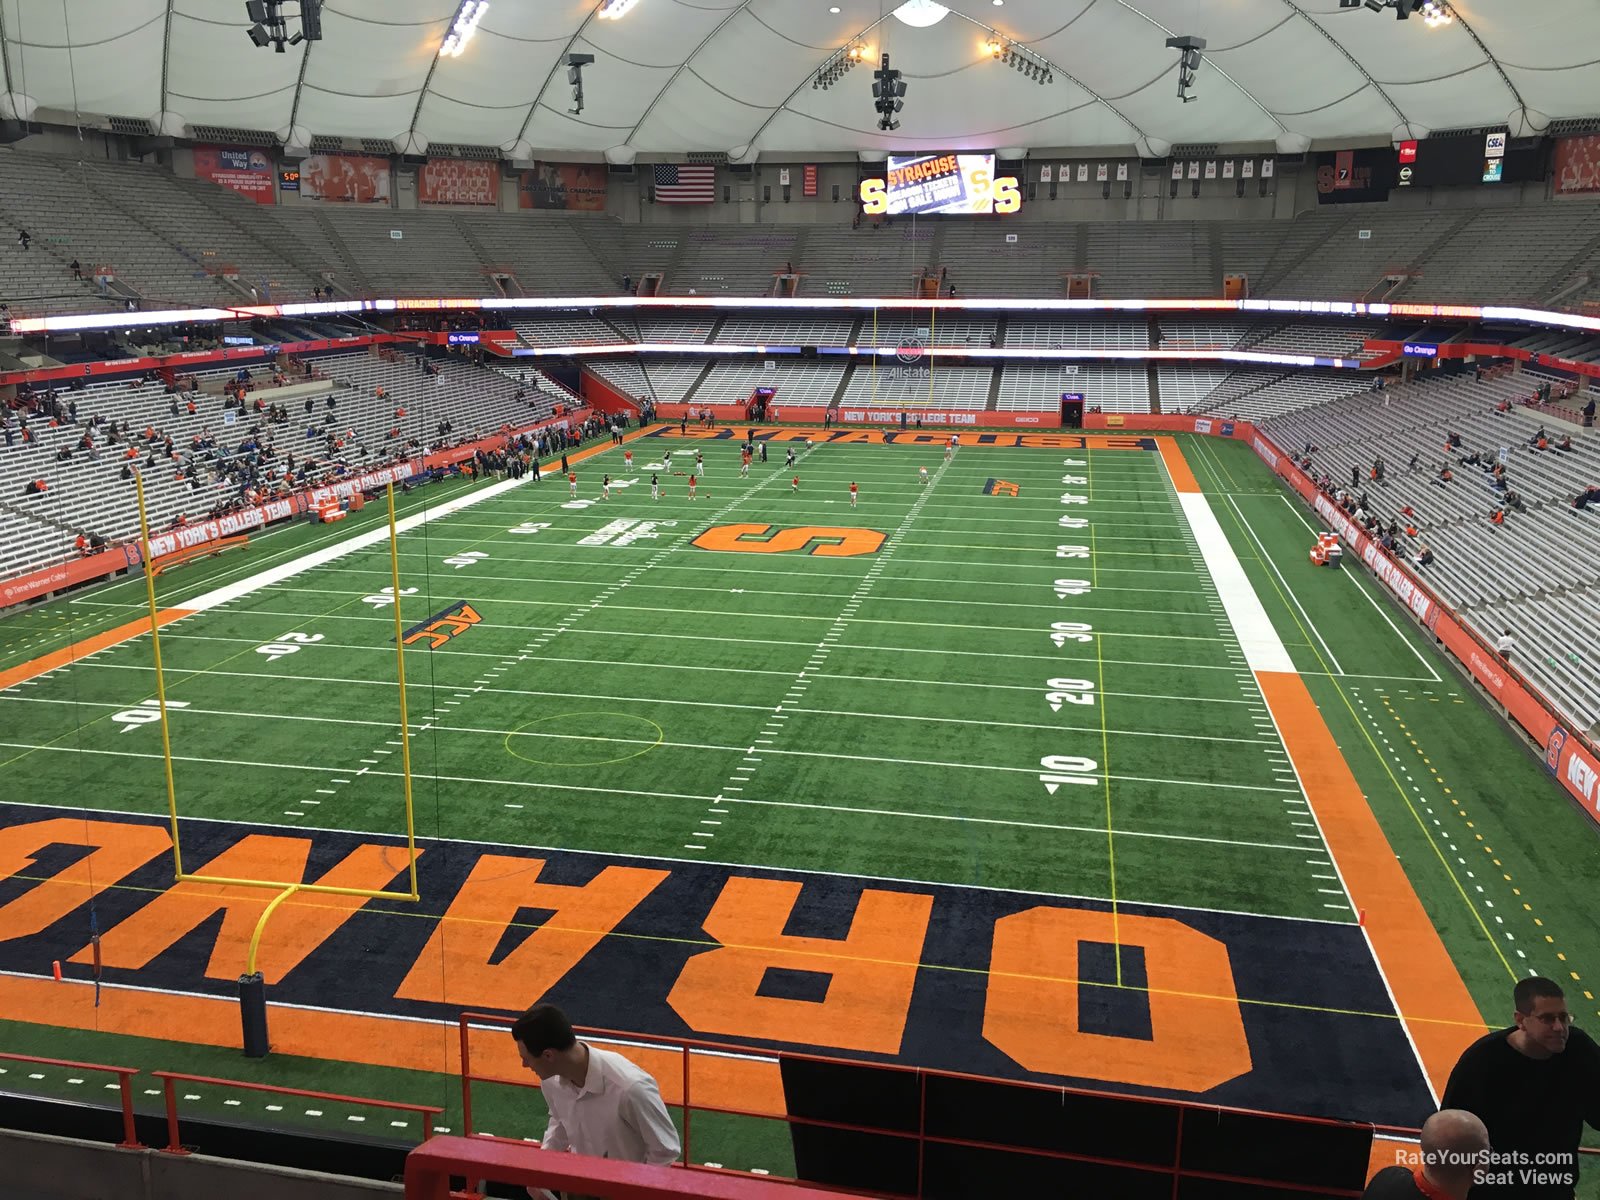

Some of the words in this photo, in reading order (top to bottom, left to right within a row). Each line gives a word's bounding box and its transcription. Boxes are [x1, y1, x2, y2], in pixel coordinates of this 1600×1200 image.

[222, 152, 247, 160] United
[232, 160, 247, 169] Way
[888, 155, 958, 186] SYRACUSE
[1340, 170, 1347, 178] 7
[860, 178, 888, 214] S
[994, 176, 1021, 214] S
[396, 300, 440, 308] SYRACUSE
[1392, 304, 1436, 316] SYRACUSE
[1414, 346, 1436, 355] Orange
[888, 367, 930, 378] Allstate
[844, 412, 864, 420] NEW
[867, 412, 901, 422] YORK'S
[905, 413, 946, 423] COLLEGE
[948, 414, 975, 423] TEAM
[653, 426, 1146, 450] SYRACUSE
[361, 470, 392, 492] COLLEGE
[392, 464, 412, 480] TEAM
[149, 535, 176, 558] NEW
[177, 522, 218, 548] YORK'S
[220, 508, 264, 533] COLLEGE
[264, 500, 291, 521] TEAM
[508, 522, 552, 534] 50
[690, 523, 890, 557] S
[127, 545, 140, 565] S
[1056, 545, 1089, 558] 50
[12, 584, 29, 594] Time
[28, 576, 51, 590] Warner
[50, 572, 68, 581] Cable
[1054, 579, 1091, 594] 40
[361, 587, 418, 604] 30
[403, 604, 482, 650] ACC
[1050, 622, 1093, 642] 30
[255, 632, 325, 655] 20
[1045, 678, 1094, 705] 20
[112, 700, 190, 724] 10
[1548, 730, 1564, 770] S
[1040, 755, 1098, 785] 10
[1567, 752, 1598, 801] NEW
